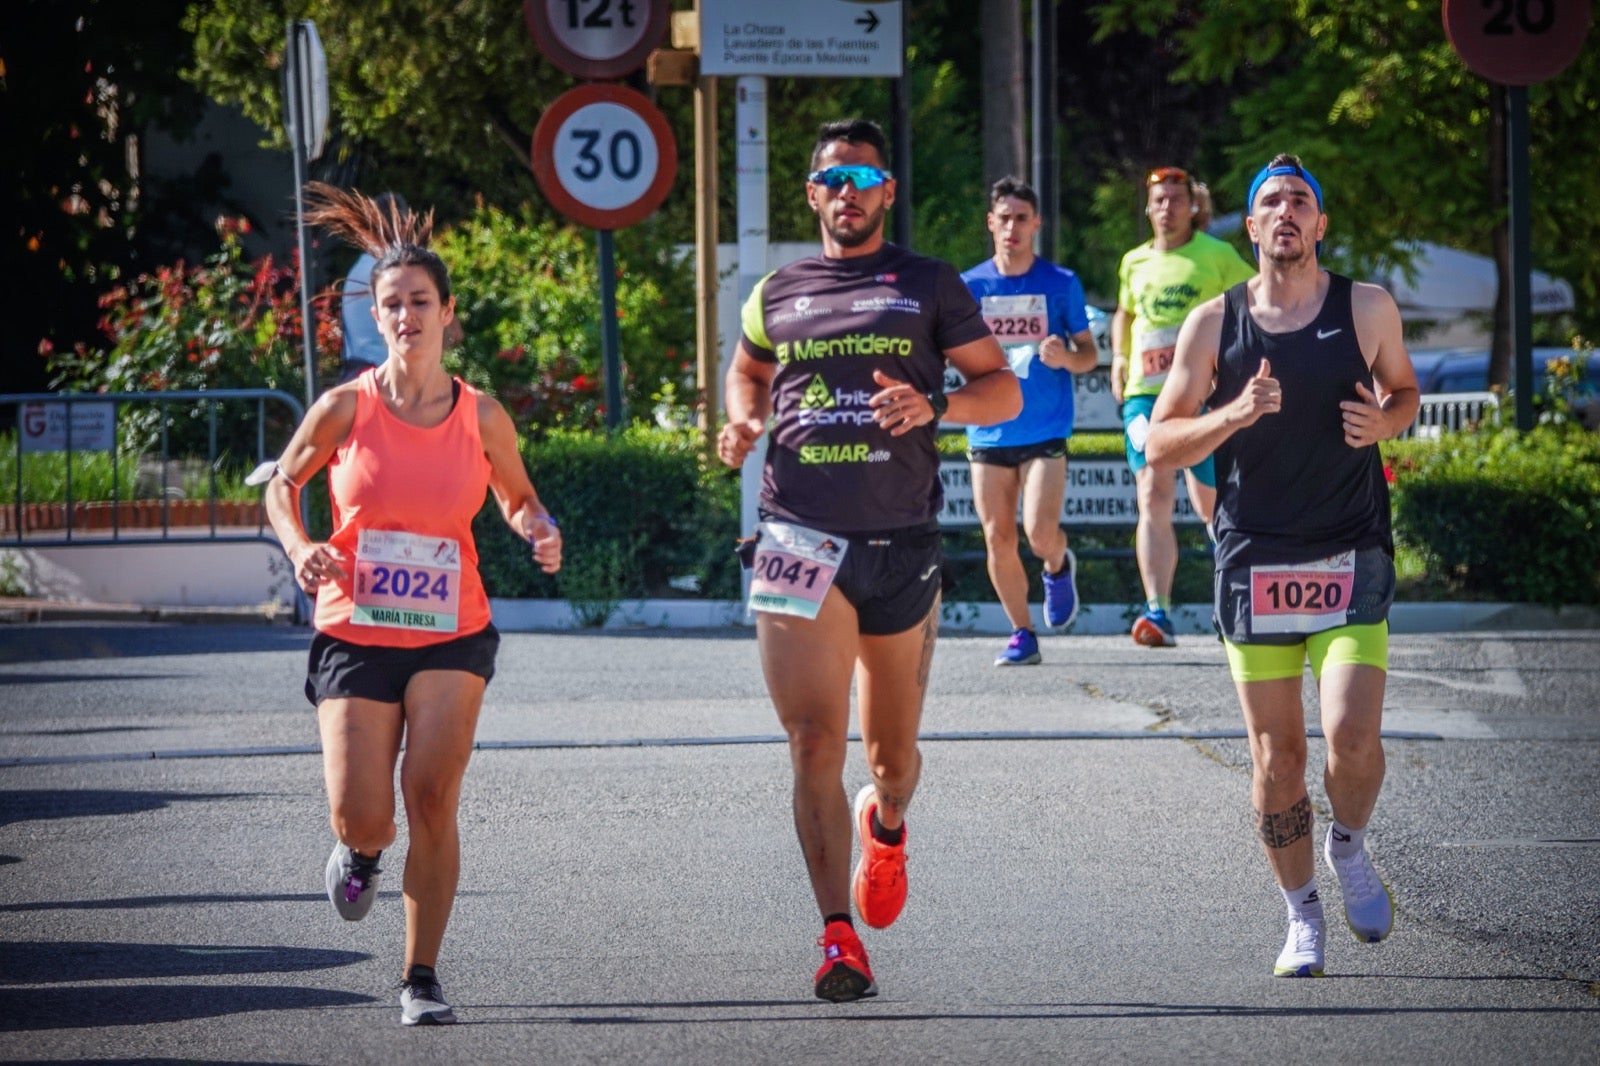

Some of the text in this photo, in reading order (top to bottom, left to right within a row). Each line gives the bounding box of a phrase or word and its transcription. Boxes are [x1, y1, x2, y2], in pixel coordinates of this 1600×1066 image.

[723, 24, 741, 35] La
[1482, 0, 1553, 34] 20
[788, 38, 803, 49] de
[806, 38, 823, 49] las
[827, 37, 880, 49] Fuentes
[723, 52, 768, 63] Puente
[571, 130, 642, 181] 30
[992, 317, 1042, 335] 2226
[793, 333, 913, 362] Mentidero
[370, 566, 449, 602] 2024
[754, 555, 821, 590] 2041
[1266, 581, 1342, 609] 1020
[371, 607, 437, 628] MARÍA TERESA
